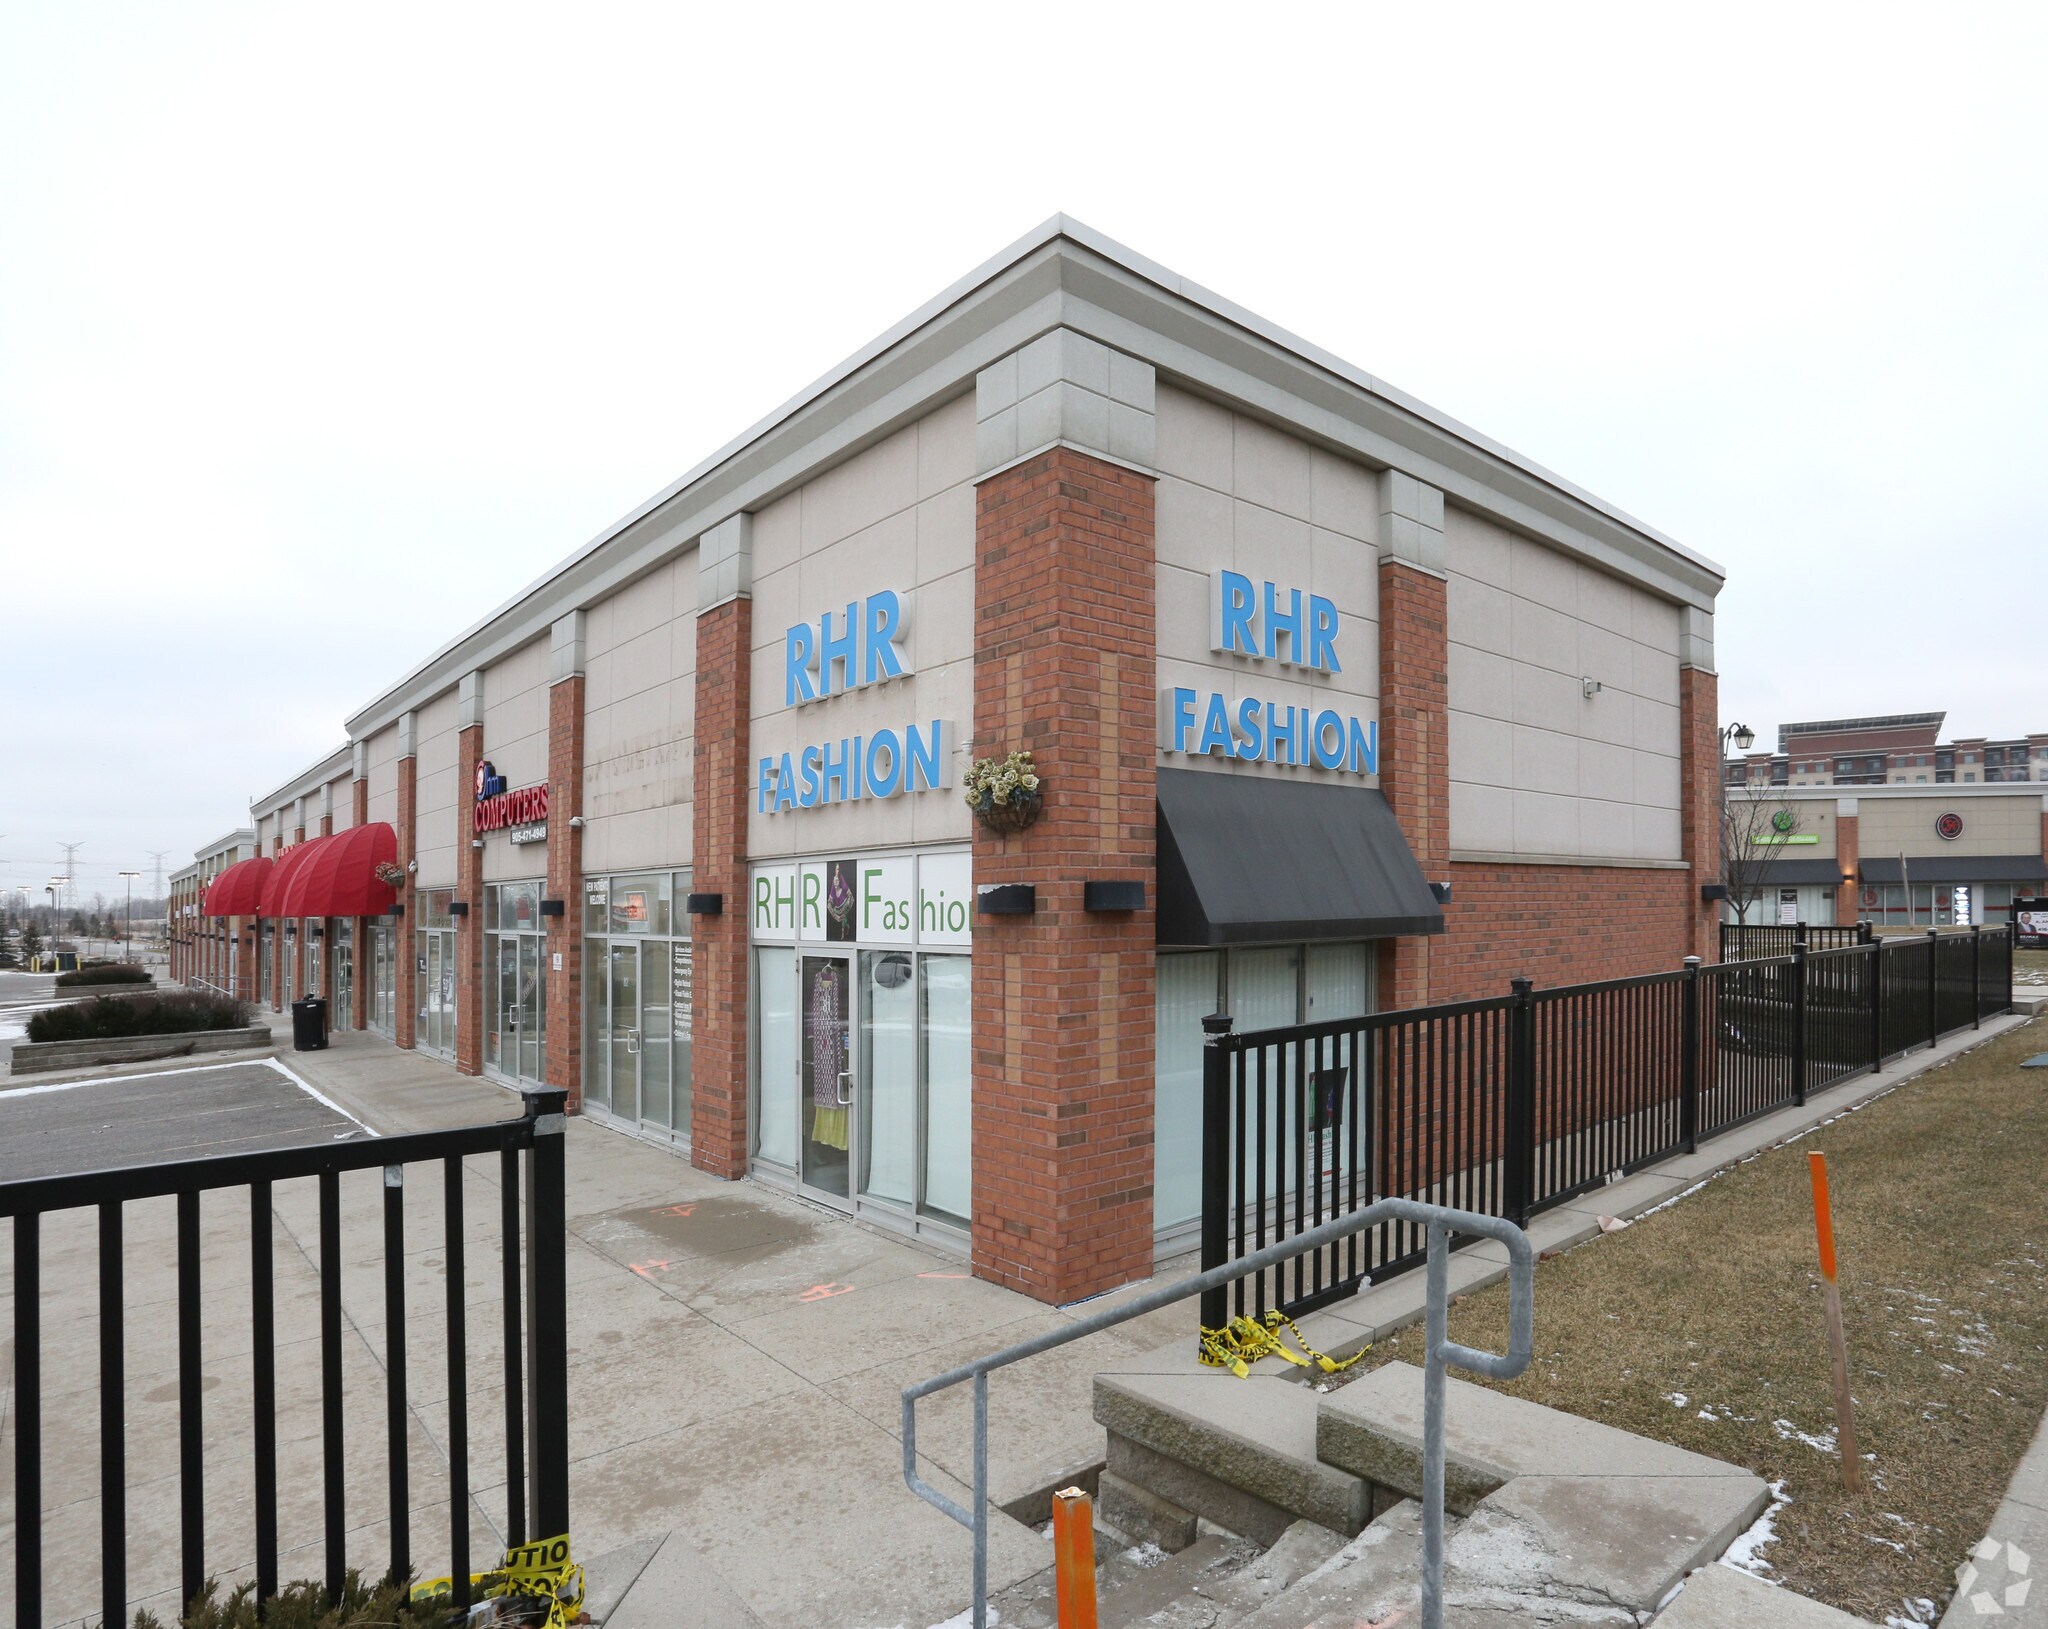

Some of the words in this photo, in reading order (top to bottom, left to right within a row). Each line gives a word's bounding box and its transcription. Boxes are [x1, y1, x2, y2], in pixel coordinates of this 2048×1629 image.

[785, 588, 906, 708] RHR
[1216, 568, 1343, 674] RHR
[757, 719, 946, 816] FASHION
[1171, 686, 1378, 776] FASHION
[474, 783, 549, 832] COMPUTERS
[511, 826, 547, 843] 905-471-4949
[755, 872, 821, 929] RHR
[863, 868, 973, 933] Fashio
